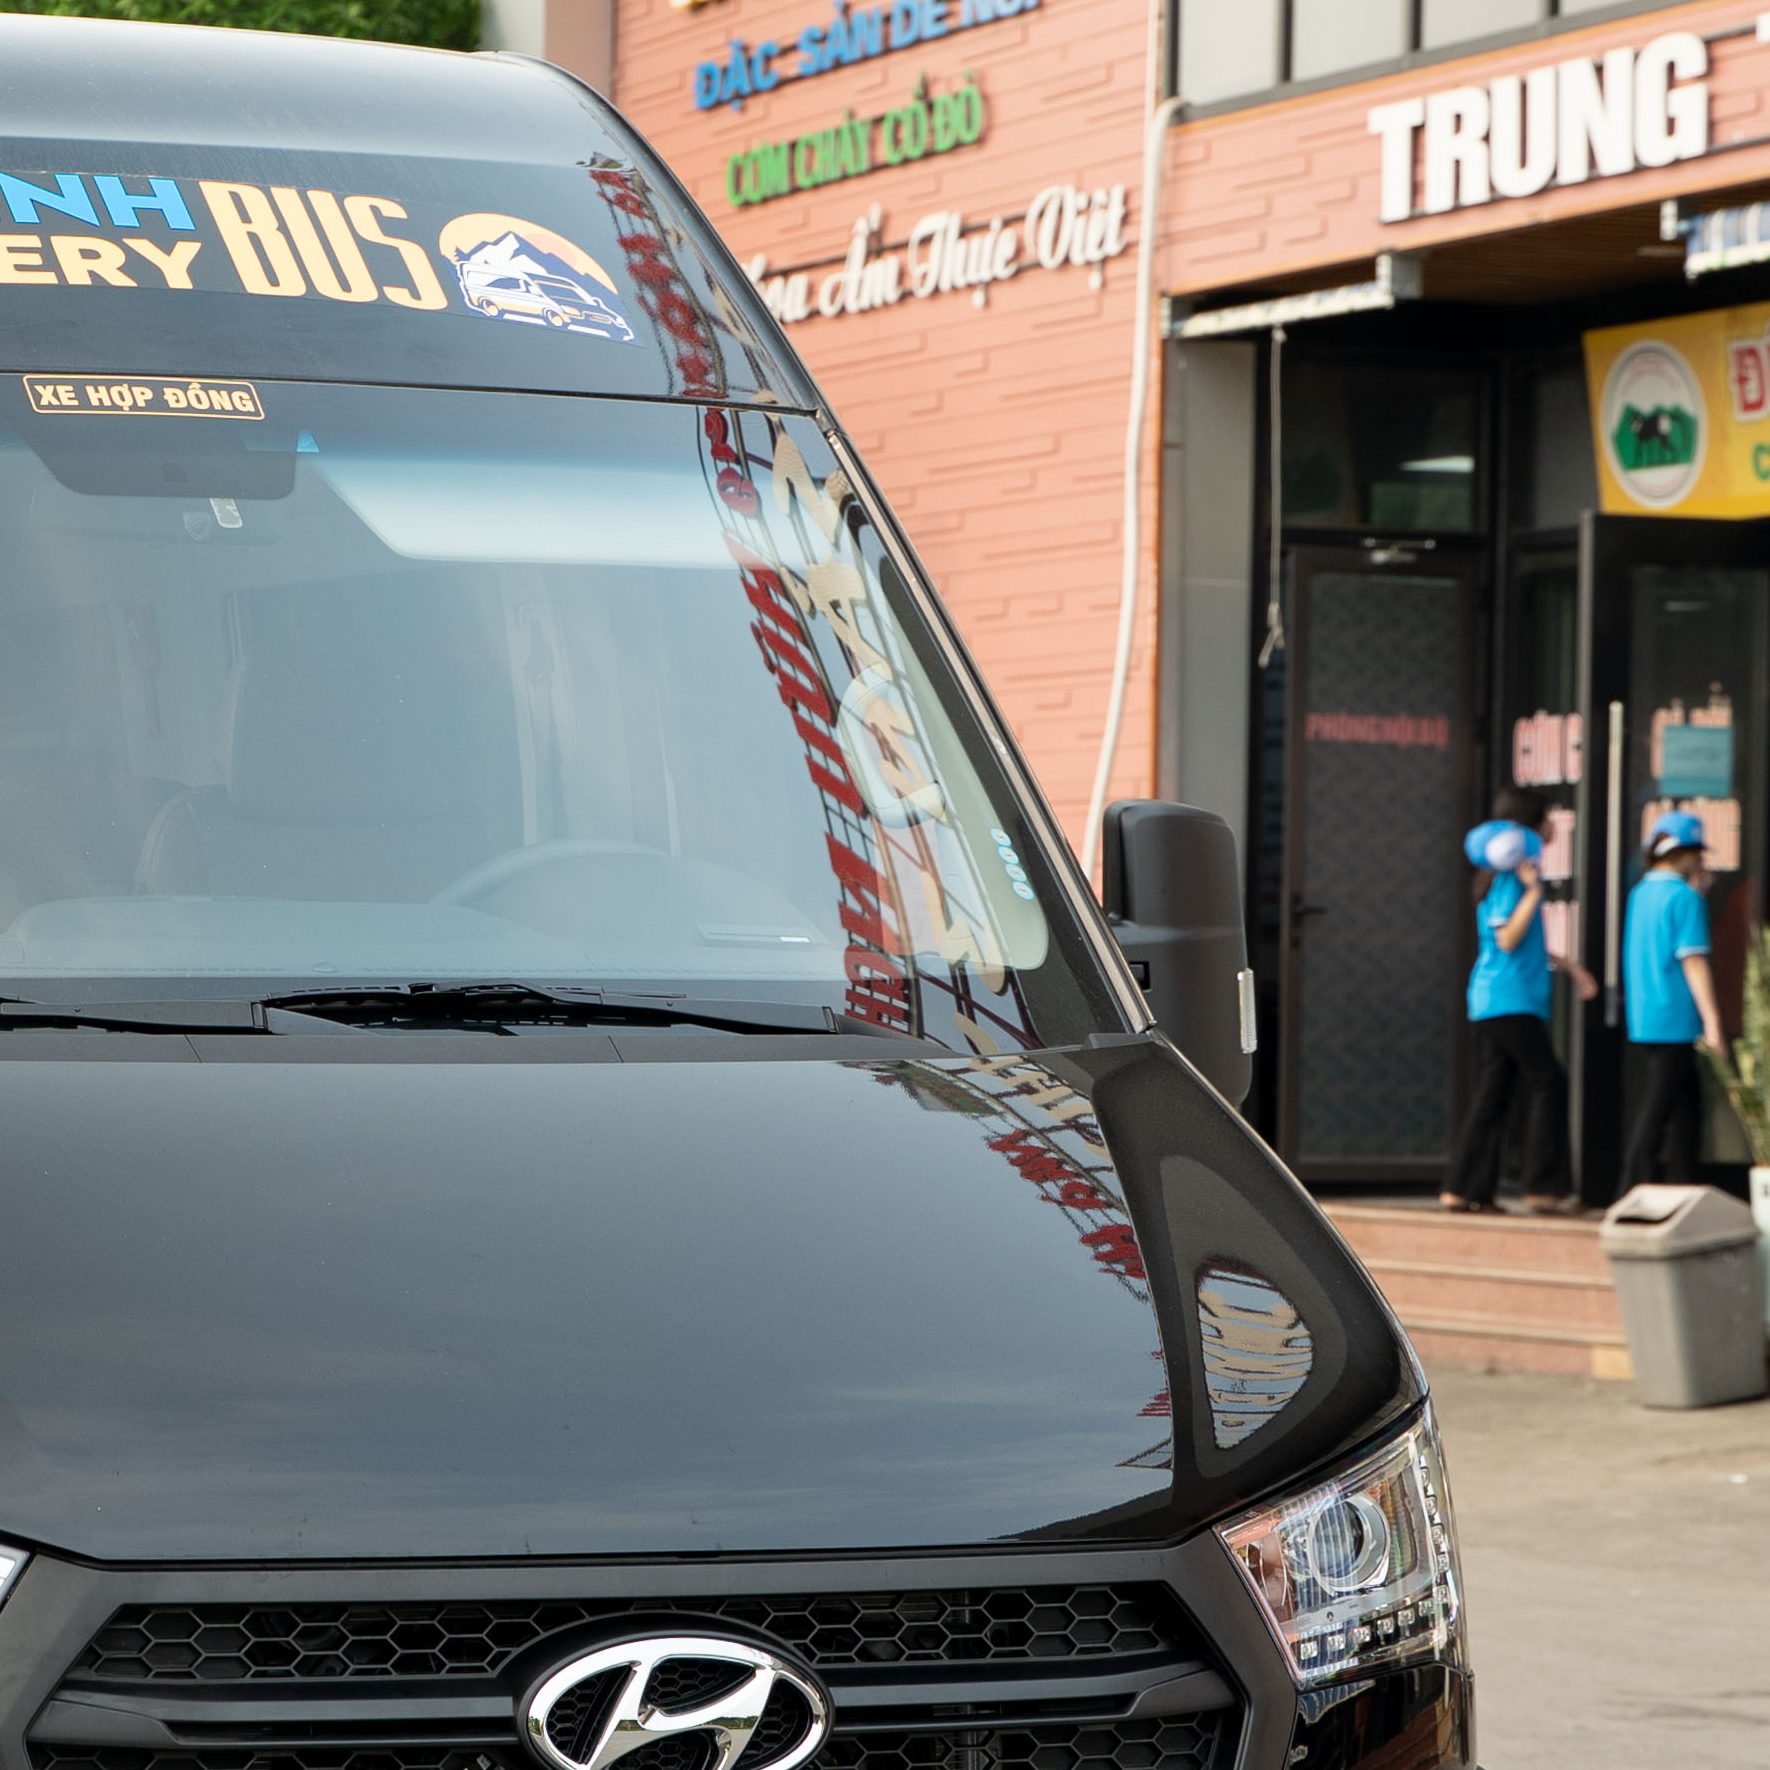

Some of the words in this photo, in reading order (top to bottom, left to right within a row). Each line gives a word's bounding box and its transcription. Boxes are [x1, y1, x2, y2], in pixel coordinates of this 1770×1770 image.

[693, 36, 781, 111] ĐẶC
[1367, 30, 1711, 224] TRUNG
[198, 180, 449, 311] BUS
[1025, 182, 1128, 293] Việt
[33, 384, 80, 406] XE
[85, 382, 154, 412] HỢP
